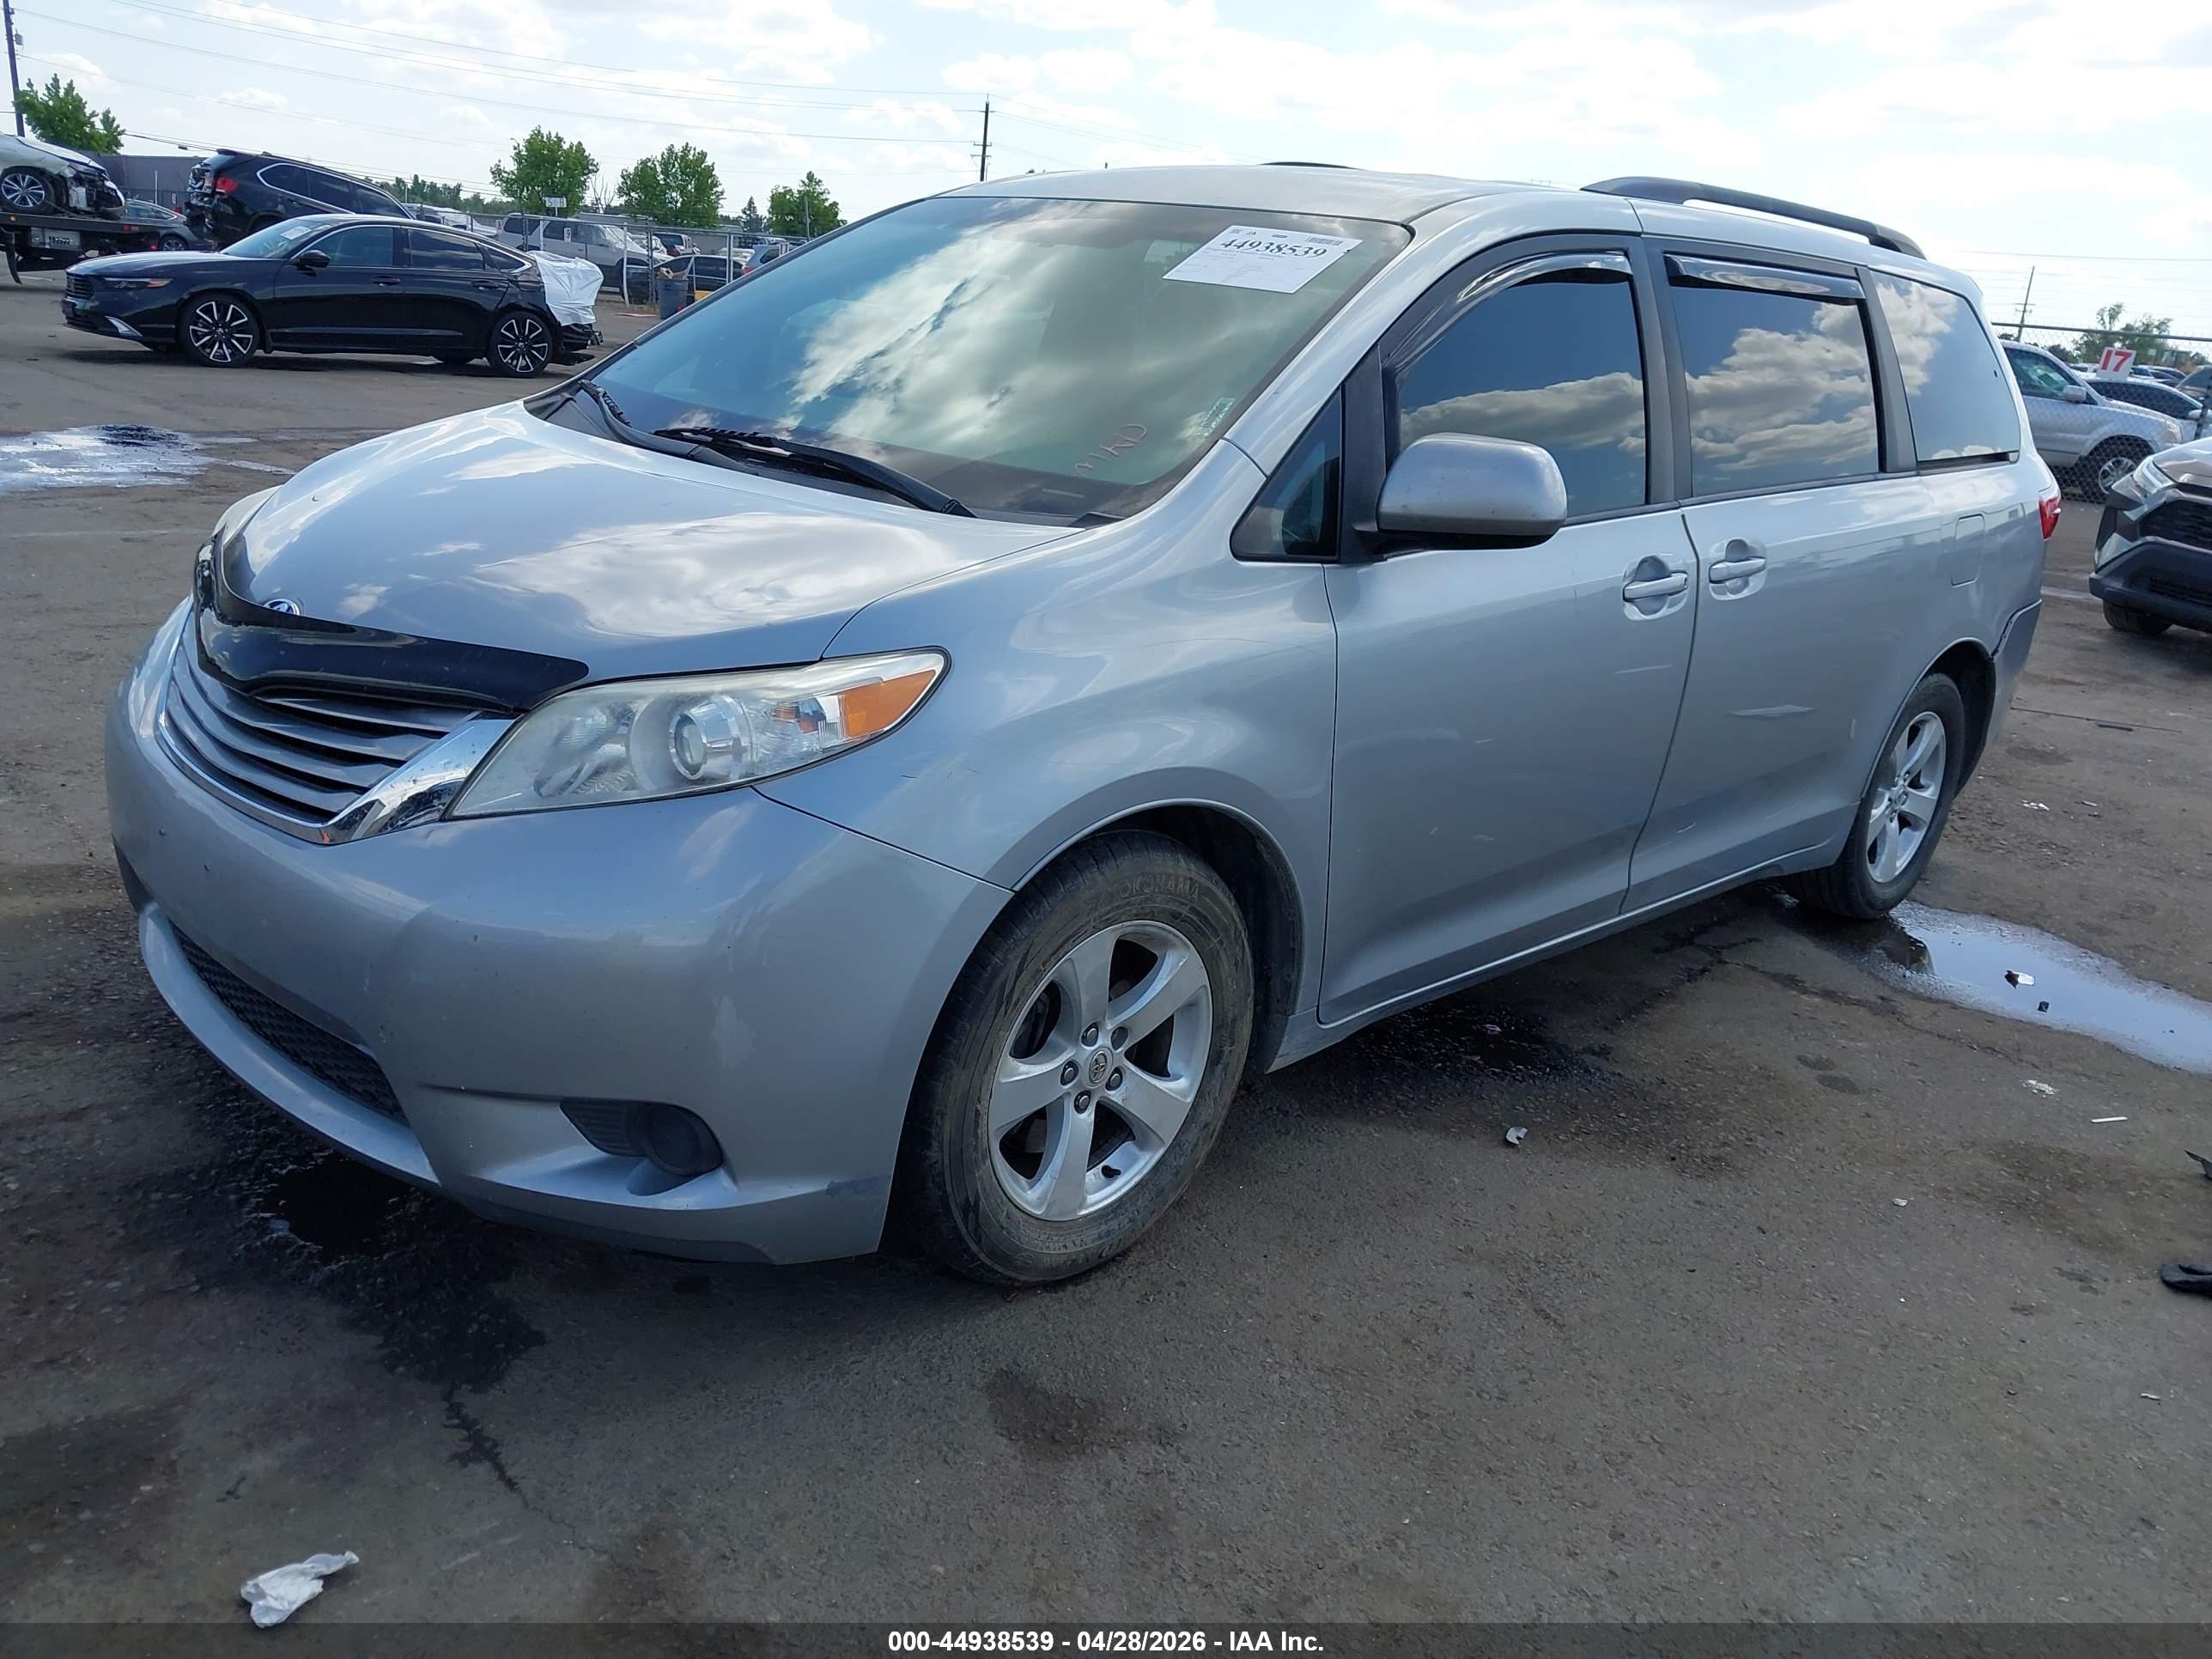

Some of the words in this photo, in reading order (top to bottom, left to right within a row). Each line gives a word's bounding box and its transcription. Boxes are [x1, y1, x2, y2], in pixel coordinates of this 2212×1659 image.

[566, 228, 570, 239] 9
[684, 238, 691, 248] 10
[1221, 238, 1328, 258] 44938539
[2101, 349, 2132, 372] 17
